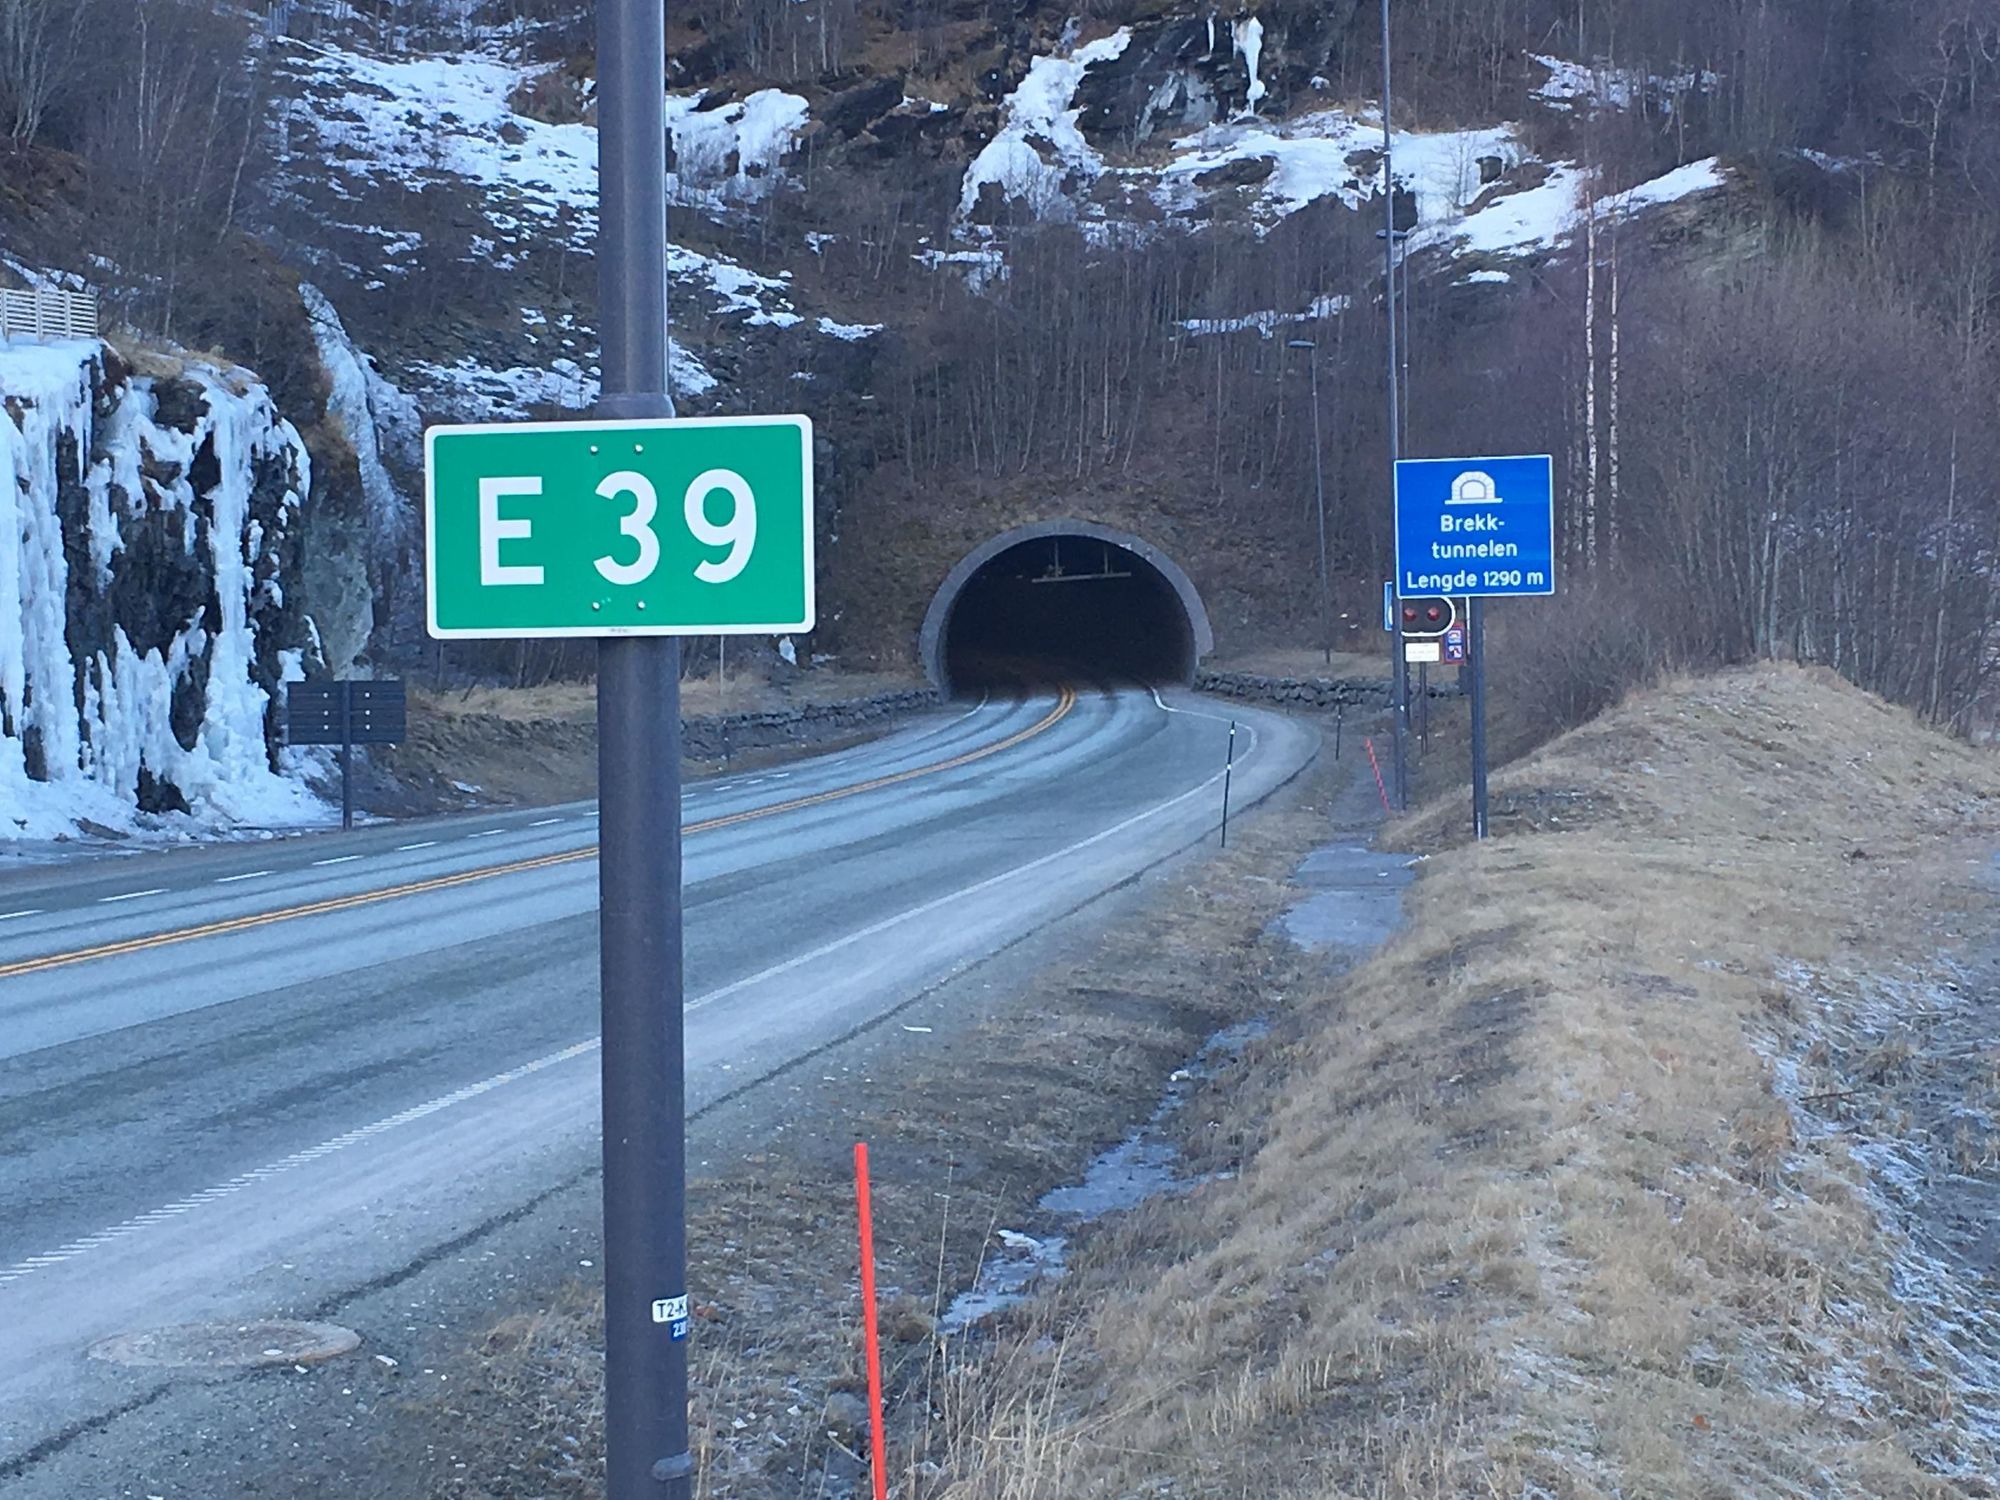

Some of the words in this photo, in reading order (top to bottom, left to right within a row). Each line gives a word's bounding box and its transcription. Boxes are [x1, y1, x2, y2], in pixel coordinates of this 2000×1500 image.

[479, 477, 544, 585] E
[594, 469, 757, 584] 39
[1440, 513, 1505, 532] Brekk-
[1431, 540, 1518, 559] tunnelen
[1407, 569, 1477, 592] Lengde
[1483, 570, 1521, 586] 1290
[1527, 571, 1544, 585] m
